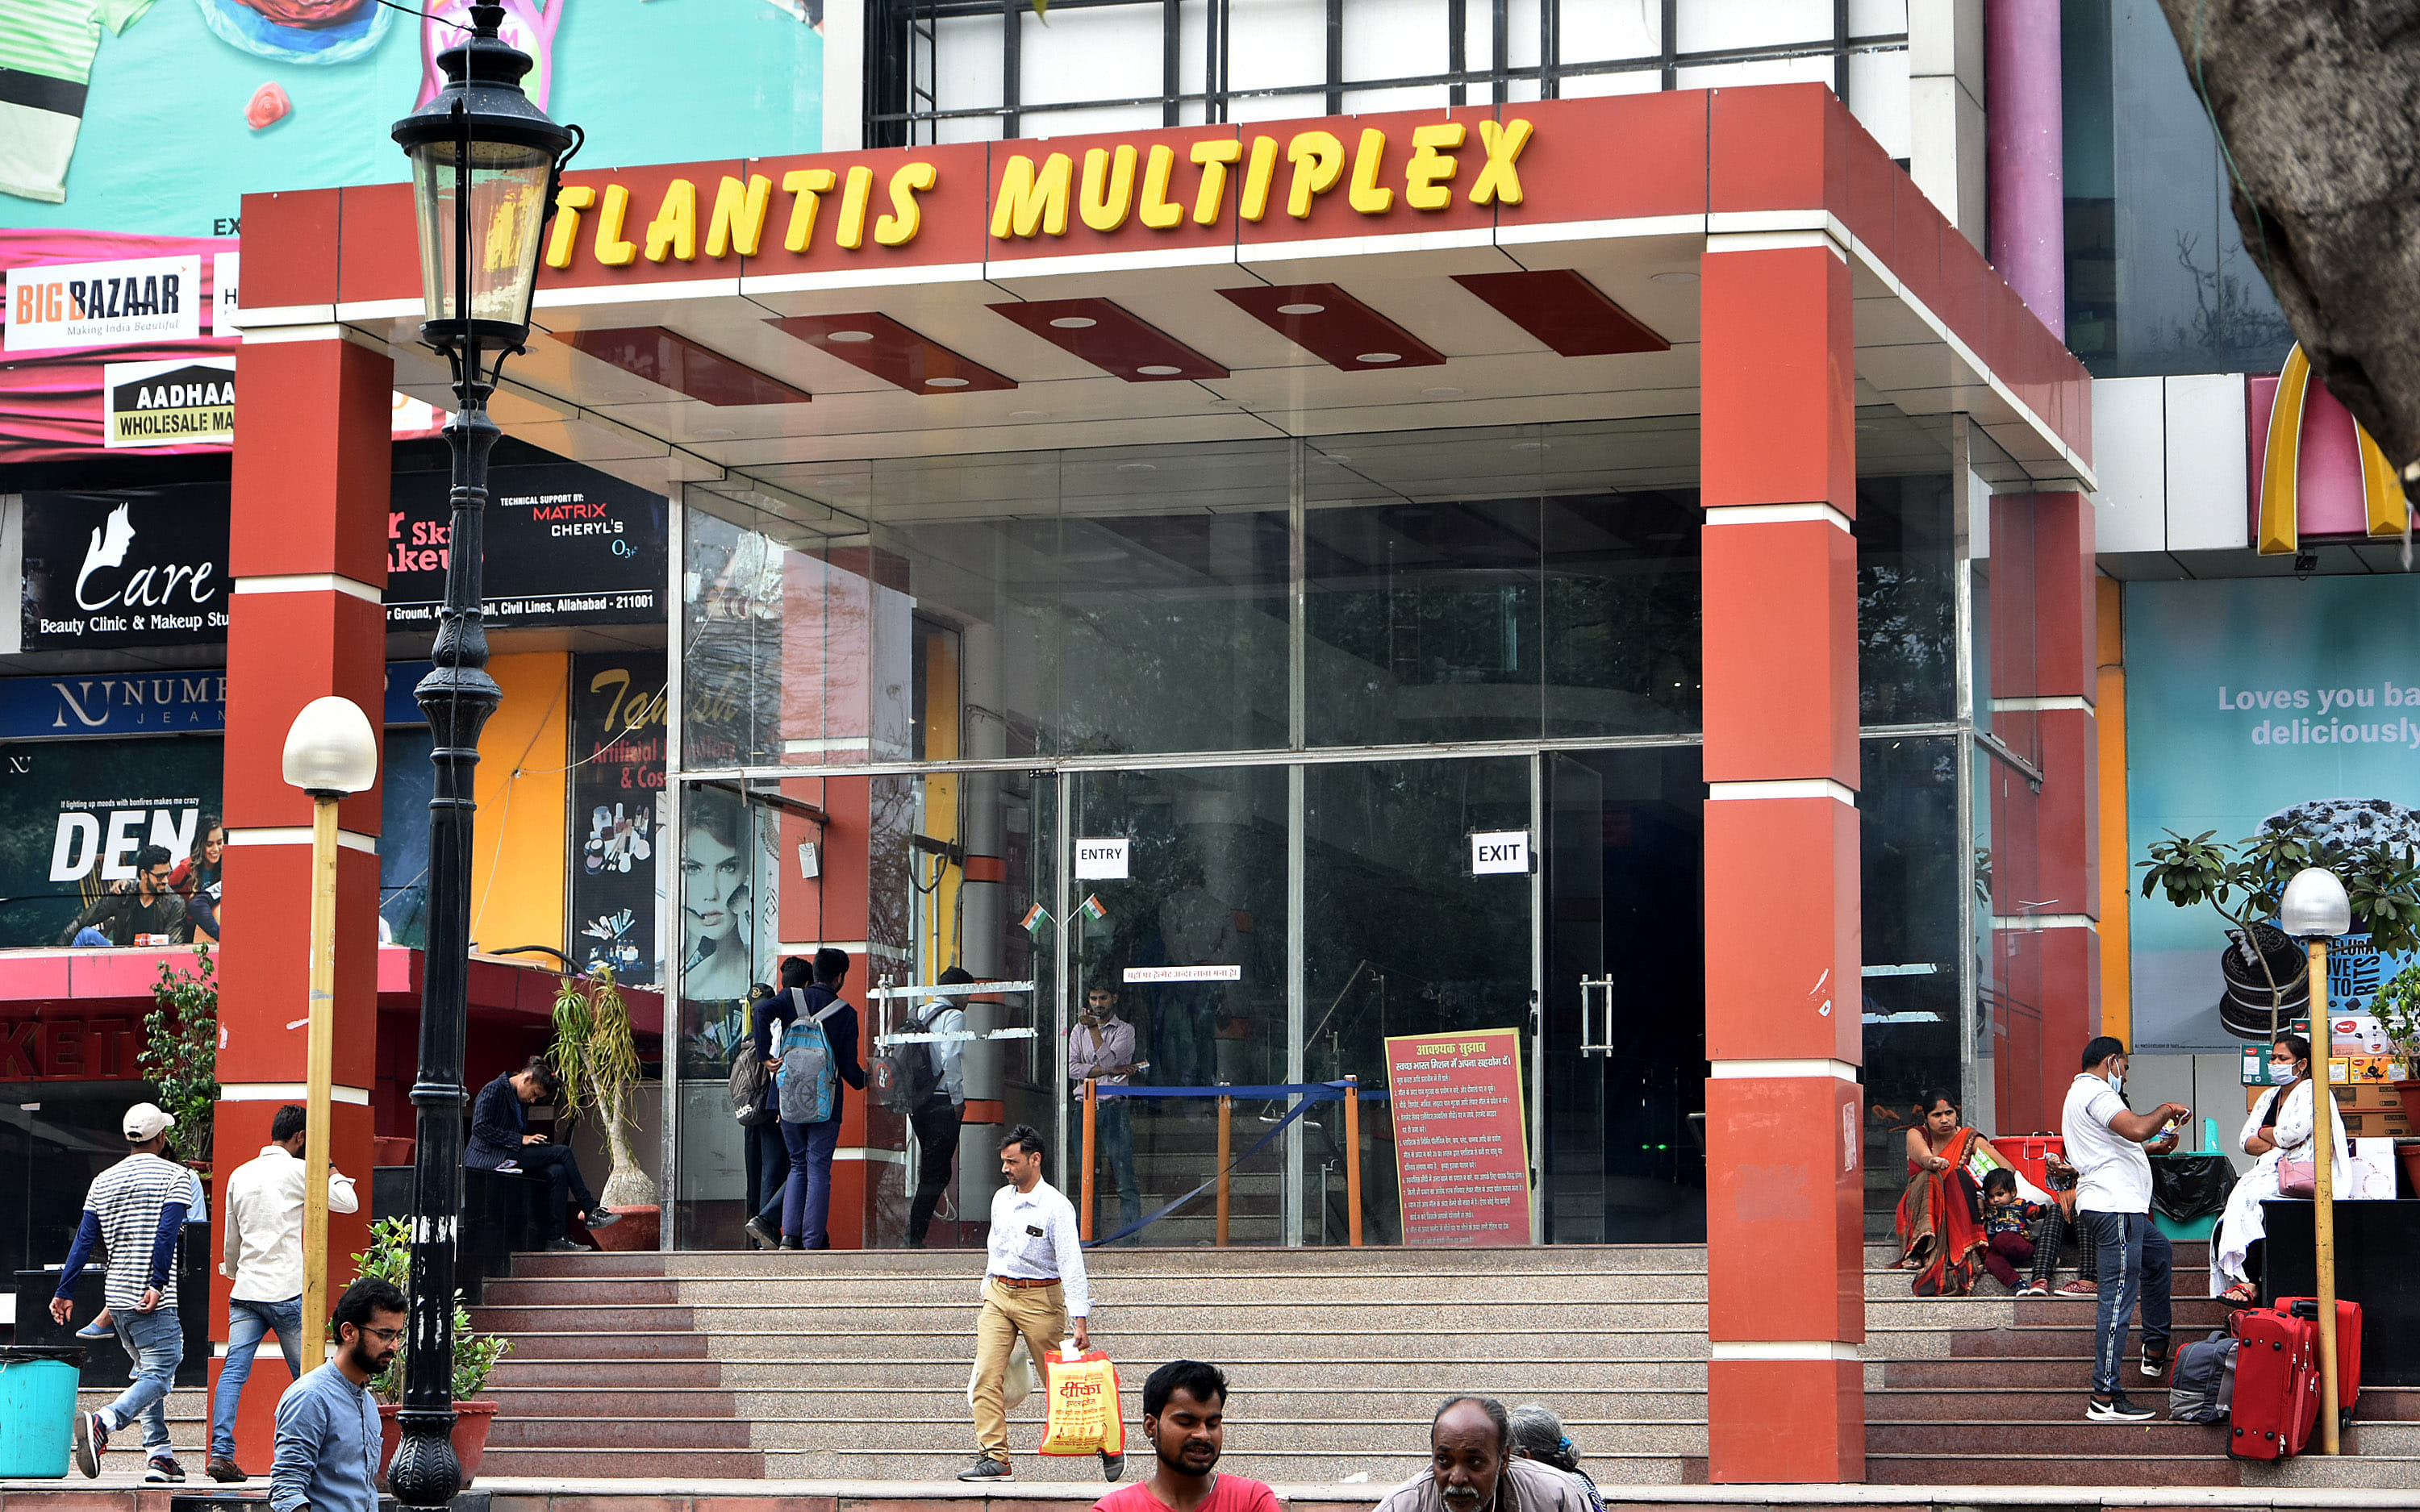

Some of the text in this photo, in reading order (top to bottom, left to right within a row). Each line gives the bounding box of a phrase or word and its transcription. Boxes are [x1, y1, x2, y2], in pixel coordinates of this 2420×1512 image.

[990, 118, 1533, 240] MULTIPLEX
[16, 273, 179, 324] BIG BAZAAR
[67, 319, 179, 337] Making India Beautiful
[136, 381, 236, 410] AADHAA
[119, 412, 207, 435] WHOLESALE
[500, 494, 584, 506] TECHNICAL SUPPORT BY:
[533, 502, 607, 521] MATRIX
[551, 519, 624, 537] CHERYL'S
[394, 607, 432, 621] Ground,
[483, 604, 499, 616] all,
[501, 602, 523, 615] Civil
[524, 600, 556, 614] Lines,
[557, 597, 607, 613] Allahabad
[615, 594, 653, 609] 211001
[40, 612, 229, 636] Beauty Clinic & Makeup Stu
[2219, 681, 2420, 715] Loves you ba
[2251, 716, 2420, 749] deliciously
[592, 738, 657, 764] Artificial
[620, 767, 632, 789] &
[116, 798, 128, 806] with
[129, 797, 152, 806] bonfires
[153, 797, 173, 806] makes
[183, 797, 199, 806] crazy
[1081, 848, 1122, 860] ENTRY
[1479, 844, 1520, 861] EXIT
[2331, 977, 2351, 997] TO
[2353, 956, 2380, 996] BITS
[1416, 1041, 1487, 1057] आवश्यक सुझाव
[1413, 1061, 1430, 1071] भारत
[1430, 1058, 1450, 1070] मिशन
[1450, 1057, 1458, 1068] में
[1458, 1059, 1476, 1068] अपना
[1477, 1056, 1502, 1068] सहयोग
